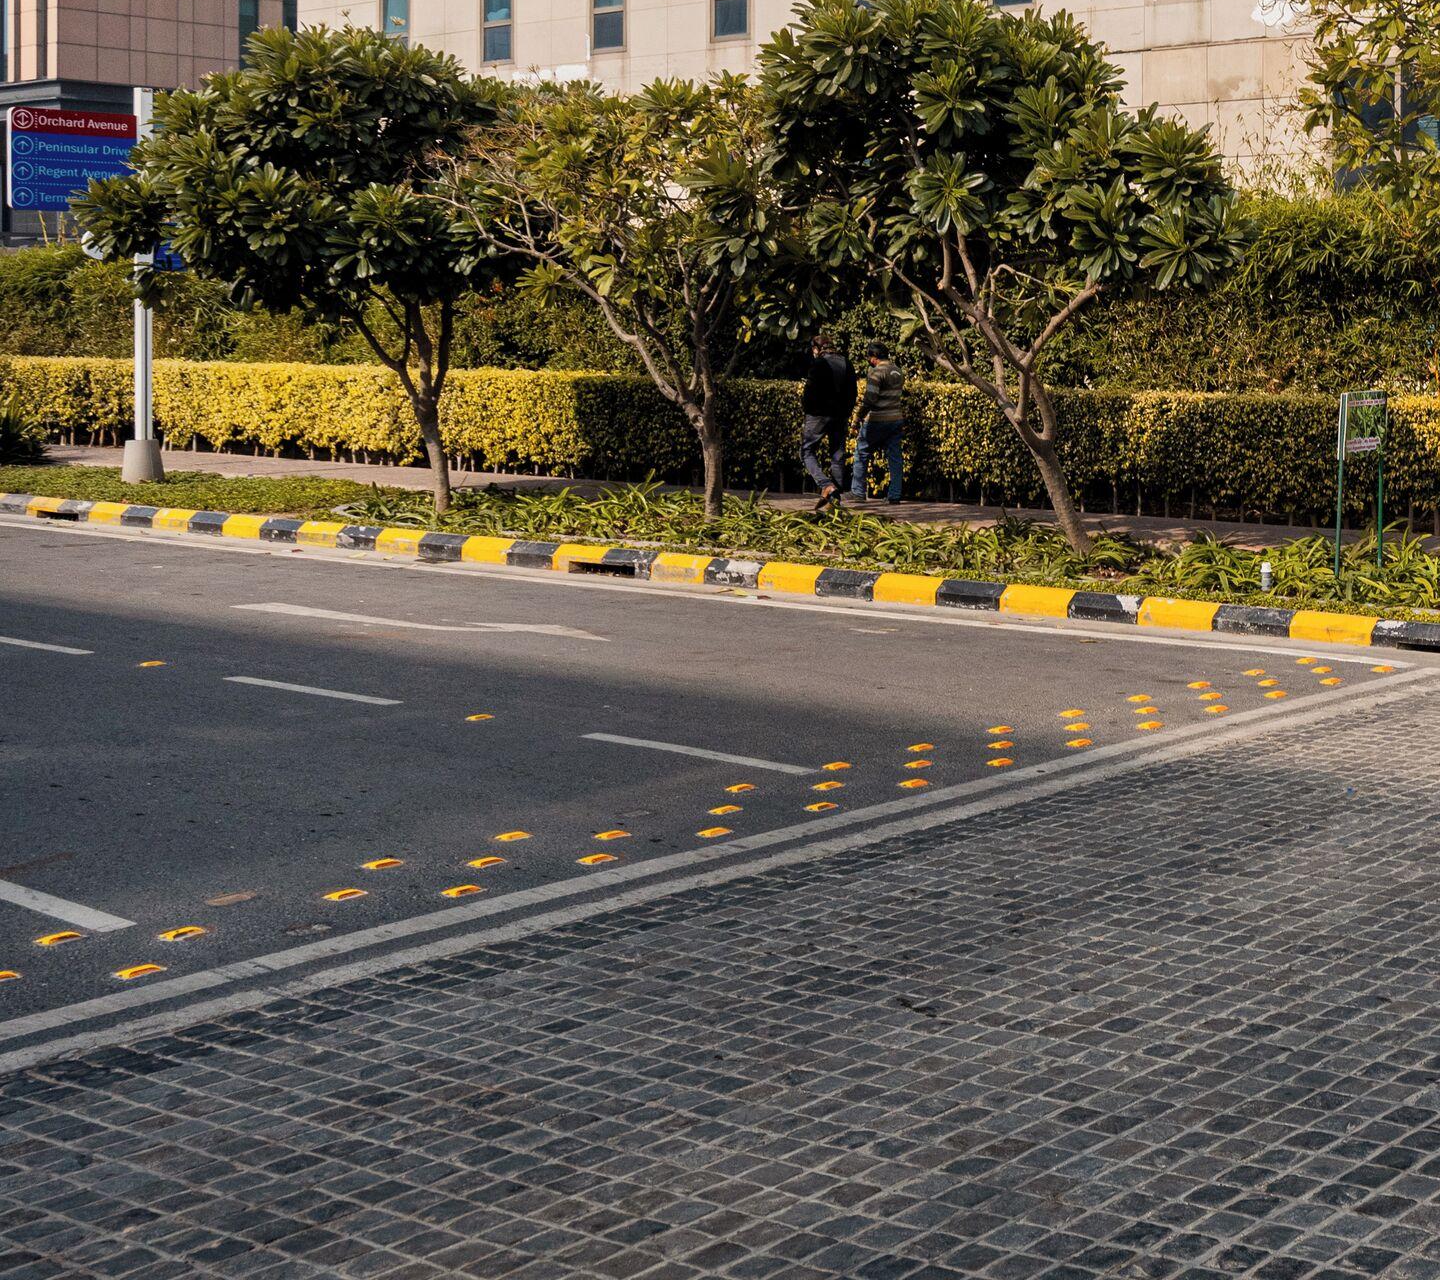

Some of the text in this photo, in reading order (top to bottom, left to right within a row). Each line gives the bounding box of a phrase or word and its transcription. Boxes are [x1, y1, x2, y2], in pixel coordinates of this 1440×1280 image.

[38, 115, 129, 132] Orchard Avenue
[38, 141, 131, 156] Peninsular Drive
[38, 165, 78, 179] Regent
